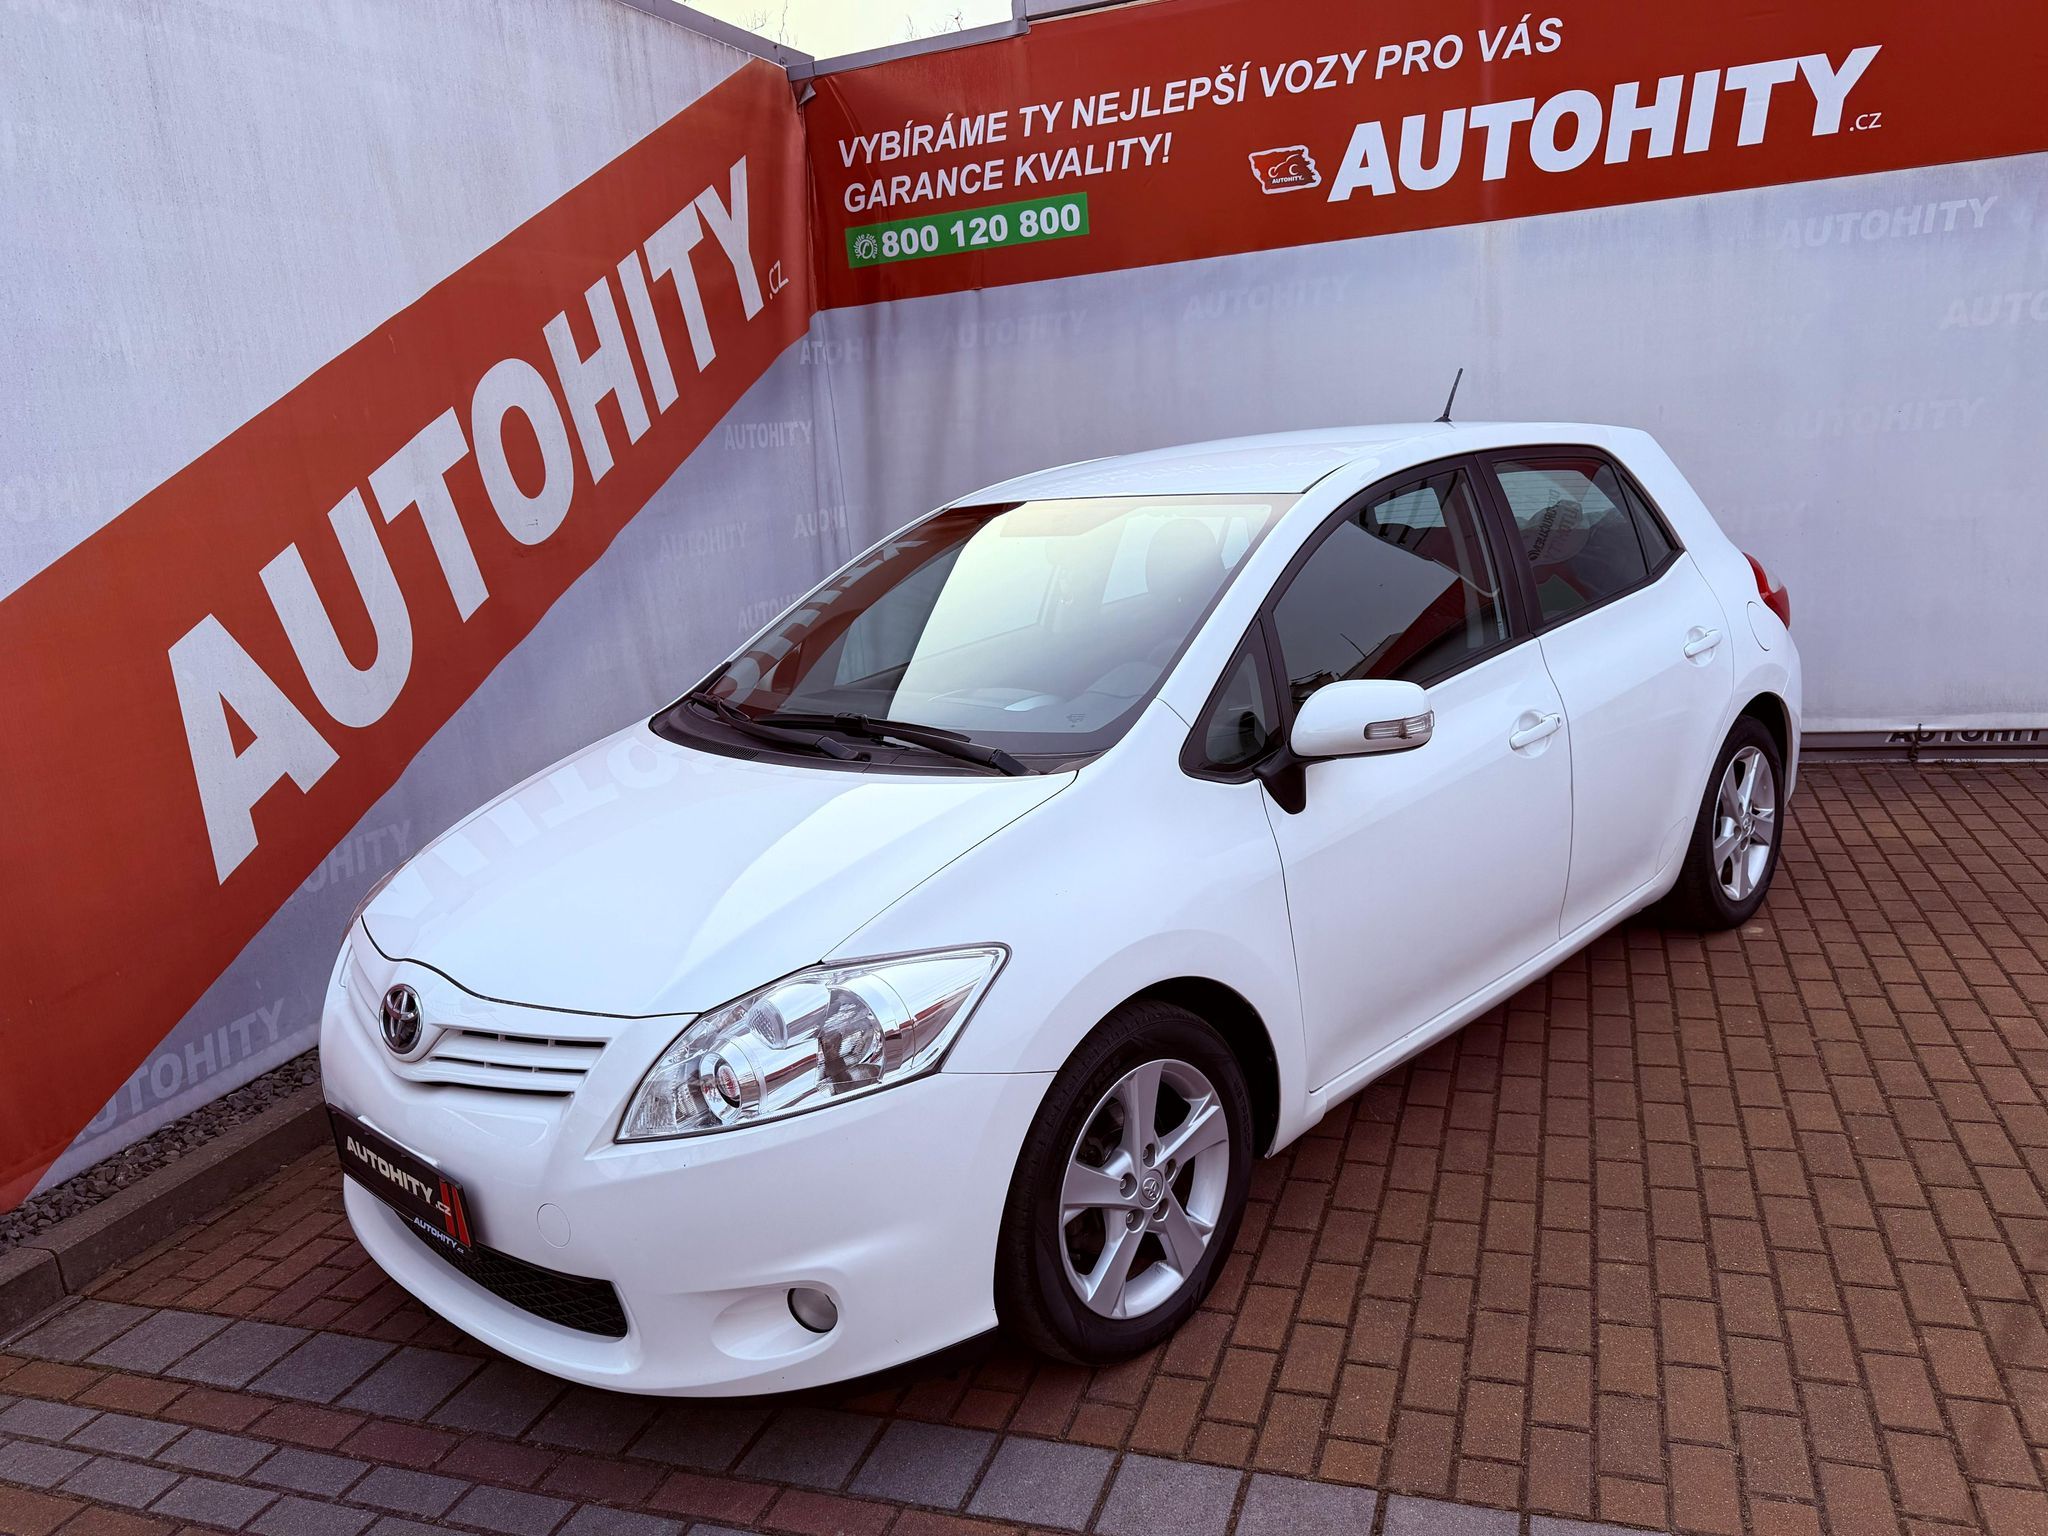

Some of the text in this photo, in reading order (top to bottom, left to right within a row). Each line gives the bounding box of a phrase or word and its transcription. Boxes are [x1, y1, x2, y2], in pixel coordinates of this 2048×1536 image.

[838, 12, 1564, 168] VYBÍRÁME TY NEJLEPŠÍ VOZY PRO VÁS
[843, 131, 1173, 213] GARANCE KVALITY!
[881, 203, 1081, 258] 800 120 800
[1778, 195, 1999, 250] AUTOHITY
[723, 418, 813, 452] AUTOHITY
